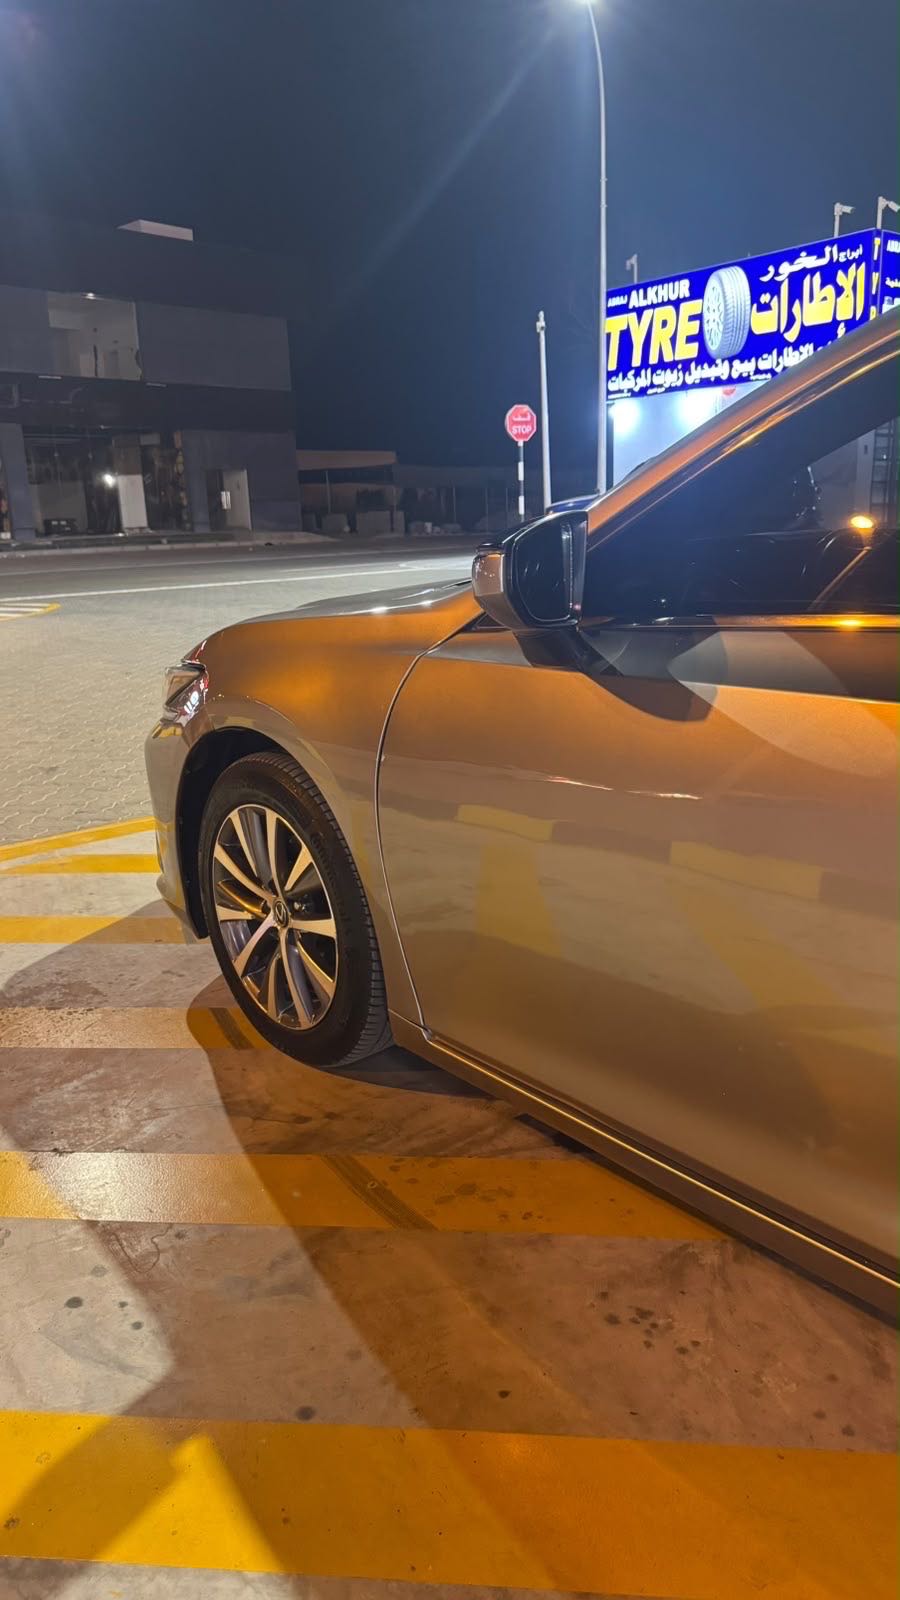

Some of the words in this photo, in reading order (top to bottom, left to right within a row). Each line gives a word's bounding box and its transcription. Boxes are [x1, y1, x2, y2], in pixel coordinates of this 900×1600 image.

[759, 243, 838, 282] الخور
[628, 278, 691, 310] ALKHUR
[750, 261, 866, 343] الاطارات
[605, 299, 703, 372] TYRE
[511, 425, 532, 435] STOP
